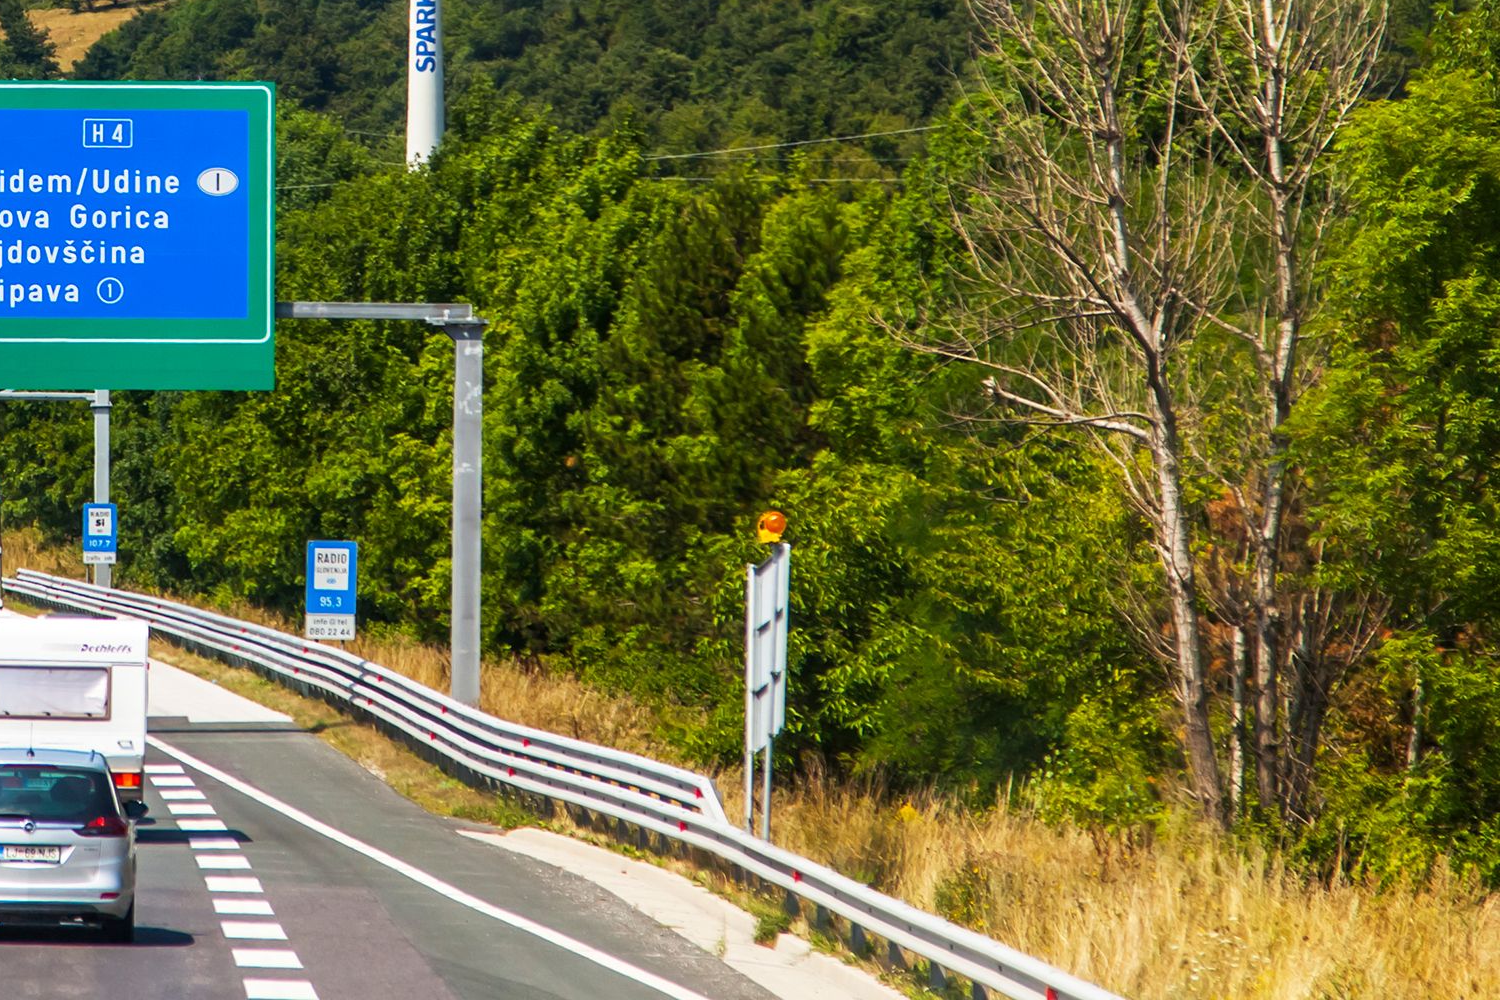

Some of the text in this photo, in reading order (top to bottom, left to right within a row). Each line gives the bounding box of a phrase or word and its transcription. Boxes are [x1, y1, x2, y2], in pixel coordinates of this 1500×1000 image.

[70, 203, 169, 229] Gorica
[89, 539, 111, 548] 107.7
[317, 552, 348, 565] RADIO
[316, 566, 348, 575] SLOVENIJA
[319, 596, 342, 608] 95.3
[309, 627, 351, 636] 080 22 44
